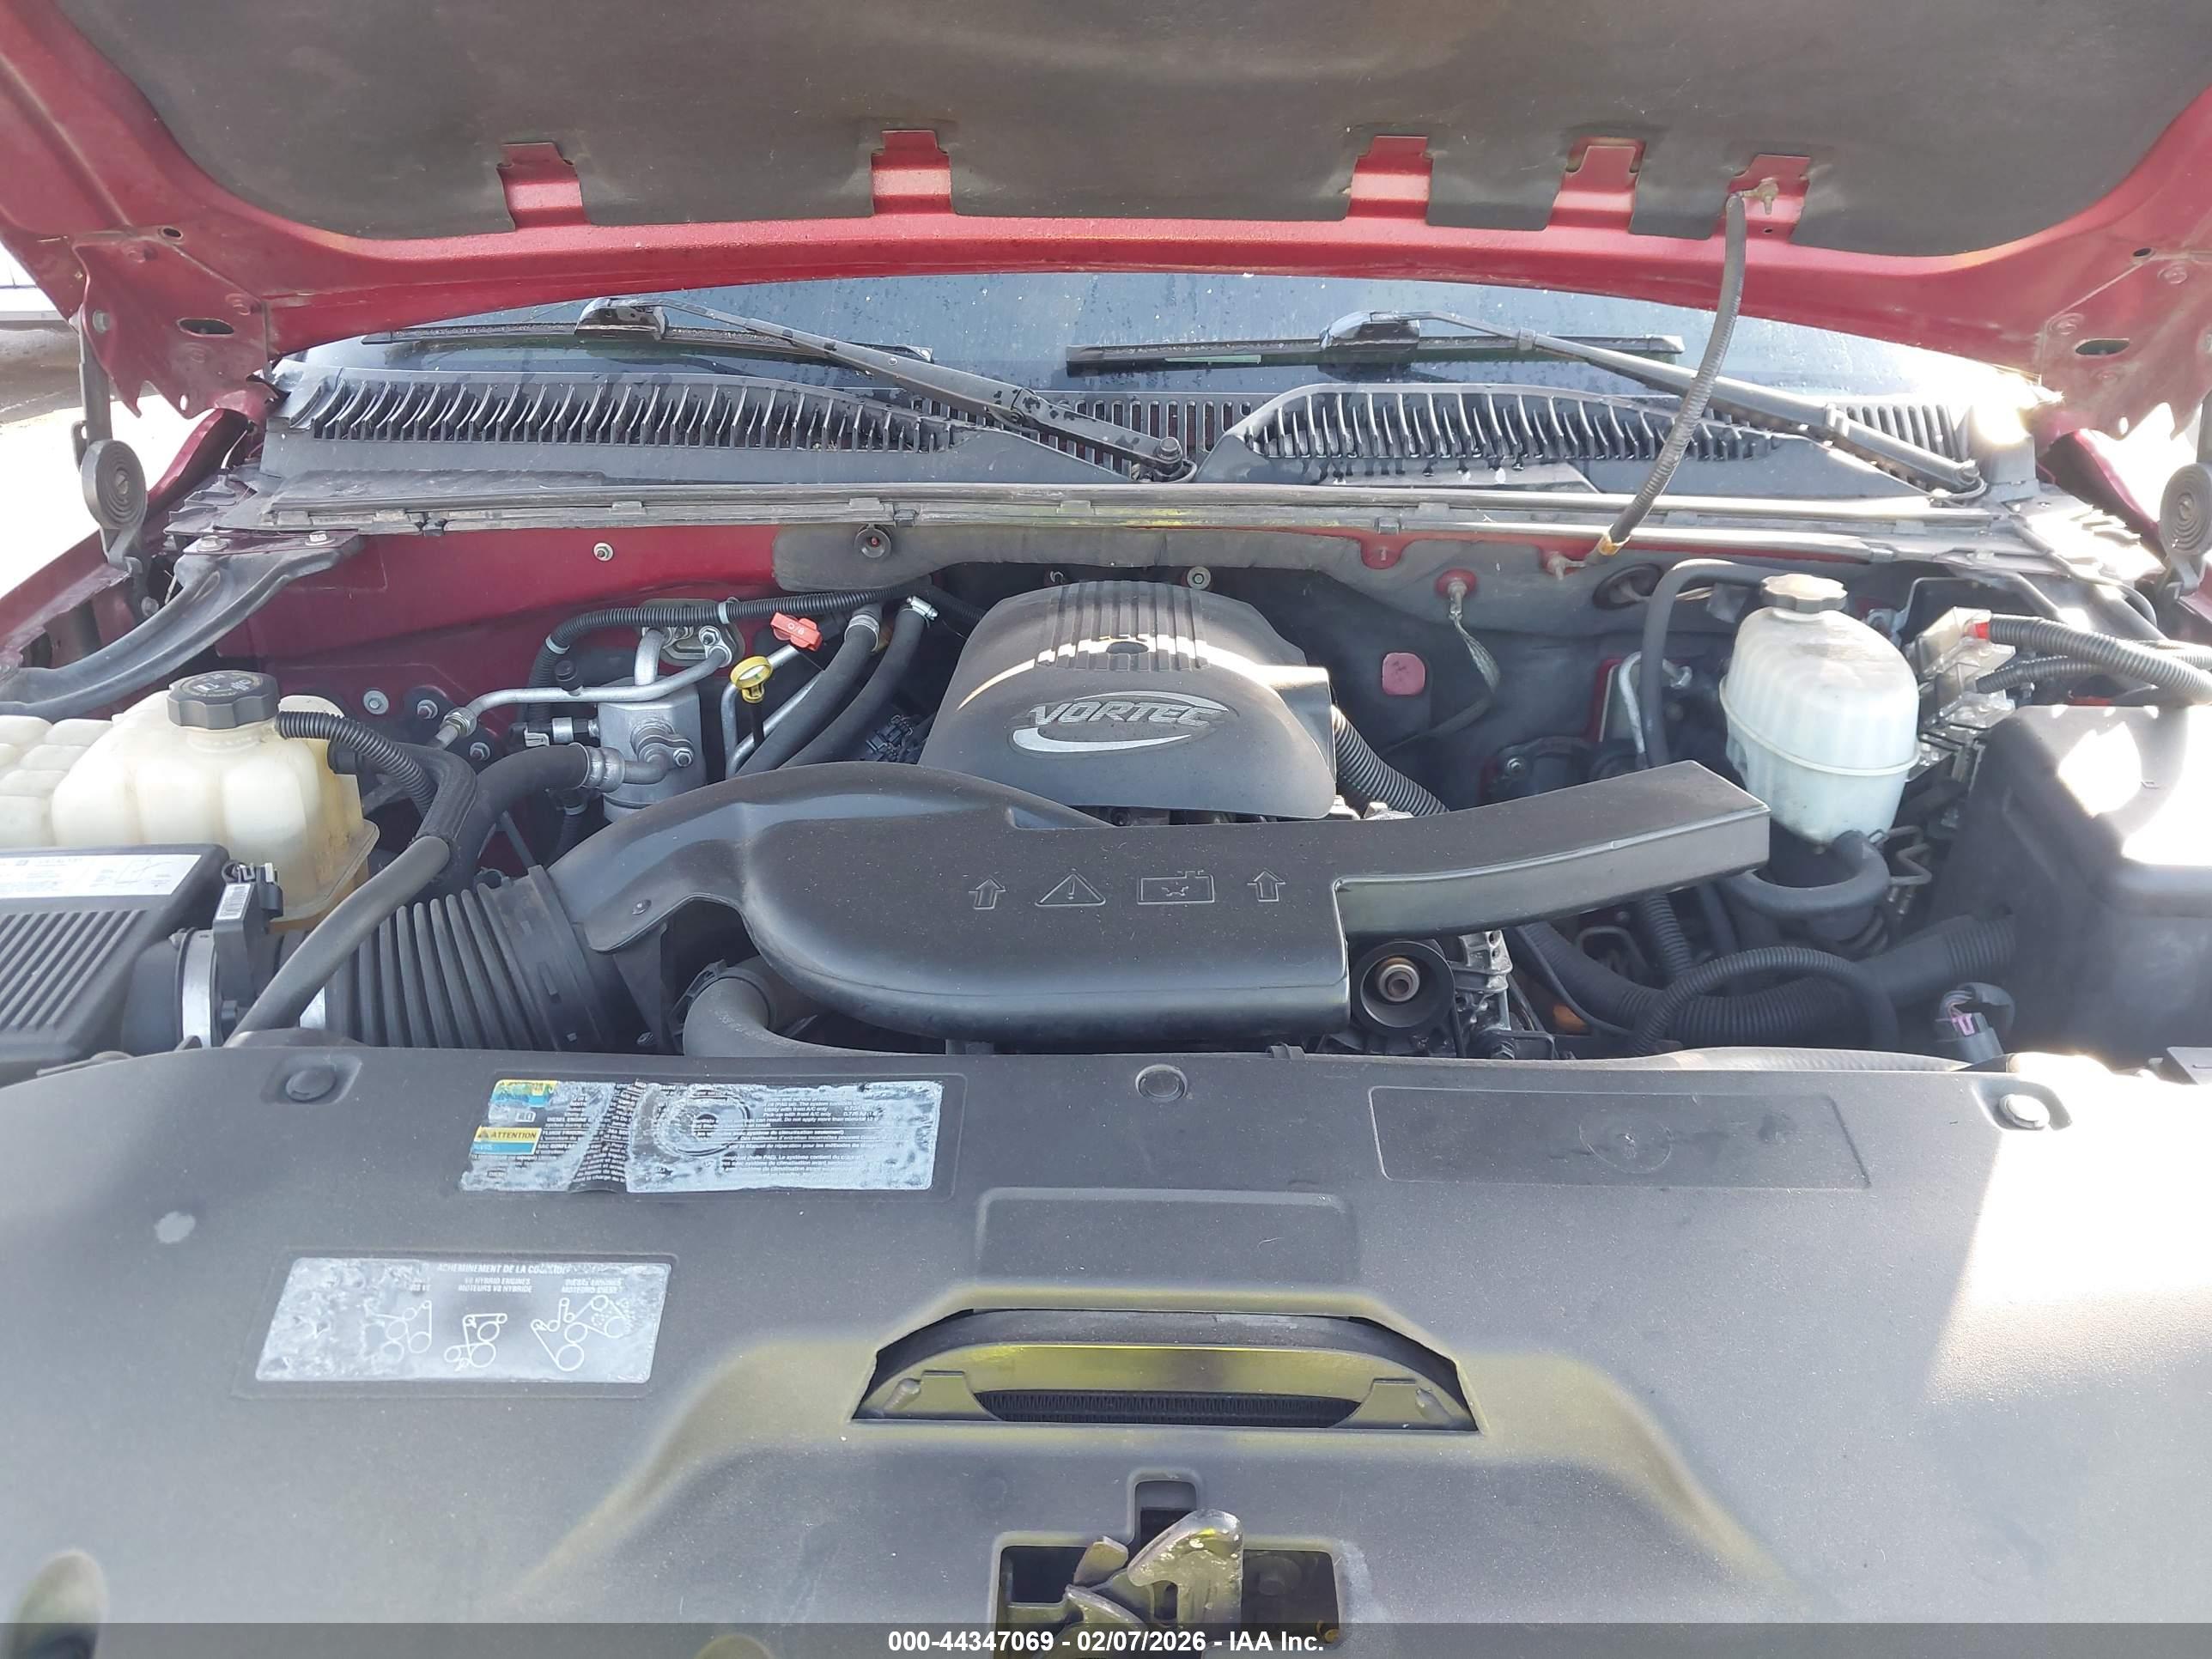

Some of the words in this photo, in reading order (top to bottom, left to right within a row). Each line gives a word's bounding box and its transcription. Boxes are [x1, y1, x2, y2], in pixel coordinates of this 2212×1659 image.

[1028, 701, 1219, 727] VORTEC
[490, 1131, 537, 1139] ATTENTION
[436, 1264, 502, 1274] ACHEMINEMENT
[503, 1264, 515, 1274] DE
[515, 1264, 527, 1274] LA
[501, 1277, 532, 1285] ENGINES
[458, 1285, 492, 1293] MOTEURS
